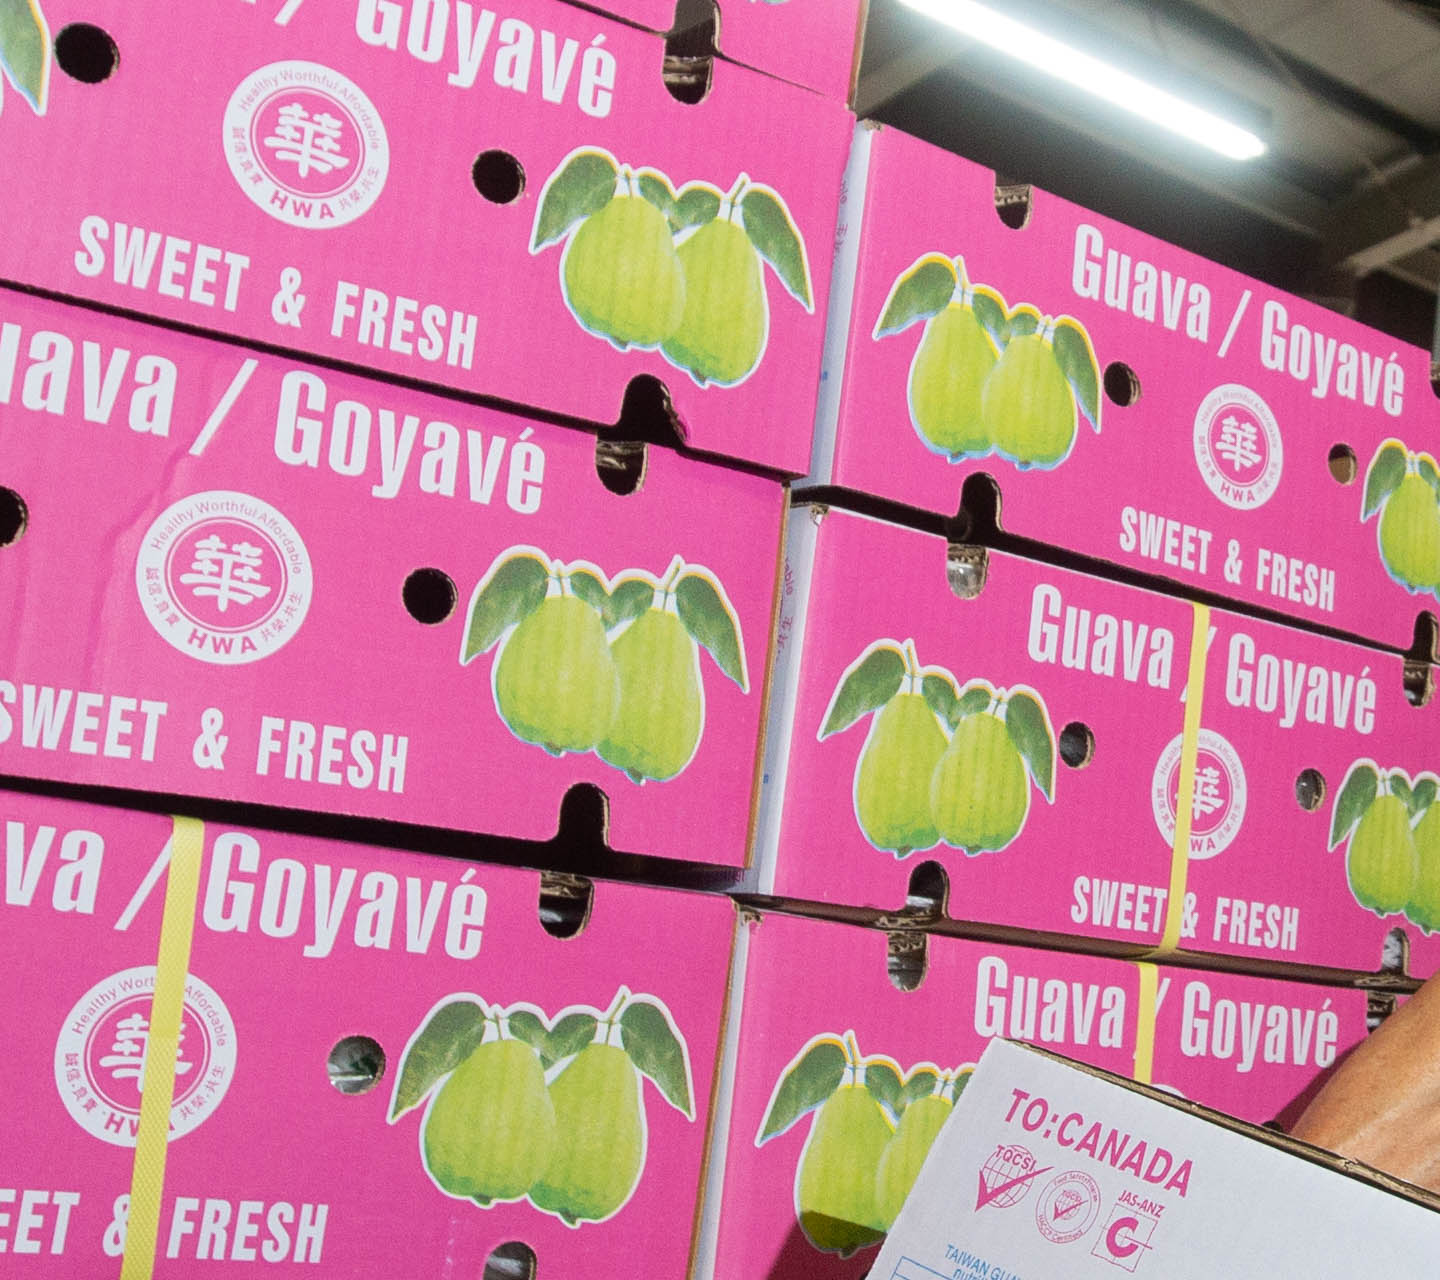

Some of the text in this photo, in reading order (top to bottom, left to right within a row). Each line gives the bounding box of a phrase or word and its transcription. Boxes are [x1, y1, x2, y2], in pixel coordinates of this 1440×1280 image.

[264, 102, 350, 179] 華
[270, 190, 335, 219] HWA
[75, 216, 478, 369] SWEET & FRESH
[1072, 224, 1210, 342] Guava
[1261, 301, 1404, 416] Goyavé
[274, 371, 545, 514] Goyavé
[1215, 416, 1262, 471] 華
[151, 508, 195, 551] Healthy
[195, 500, 258, 518] Worthful
[1220, 483, 1255, 503] HWA
[179, 534, 271, 612] 華
[1120, 507, 1334, 611] SWEET & FRESH
[187, 628, 257, 654] HWA
[1028, 584, 1376, 734] Guava Goyavé
[192, 708, 228, 770] &
[256, 716, 408, 793] FRESH
[203, 832, 487, 960] Goyavé
[1072, 876, 1299, 950] SWEET & FRESH
[974, 956, 1338, 1072] Guava Goyavé
[994, 1144, 1038, 1172] TQCSI
[167, 1197, 328, 1263] FRESH
[1118, 1190, 1166, 1219] JAS-ANZ
[945, 1244, 990, 1276] TAIWAN
